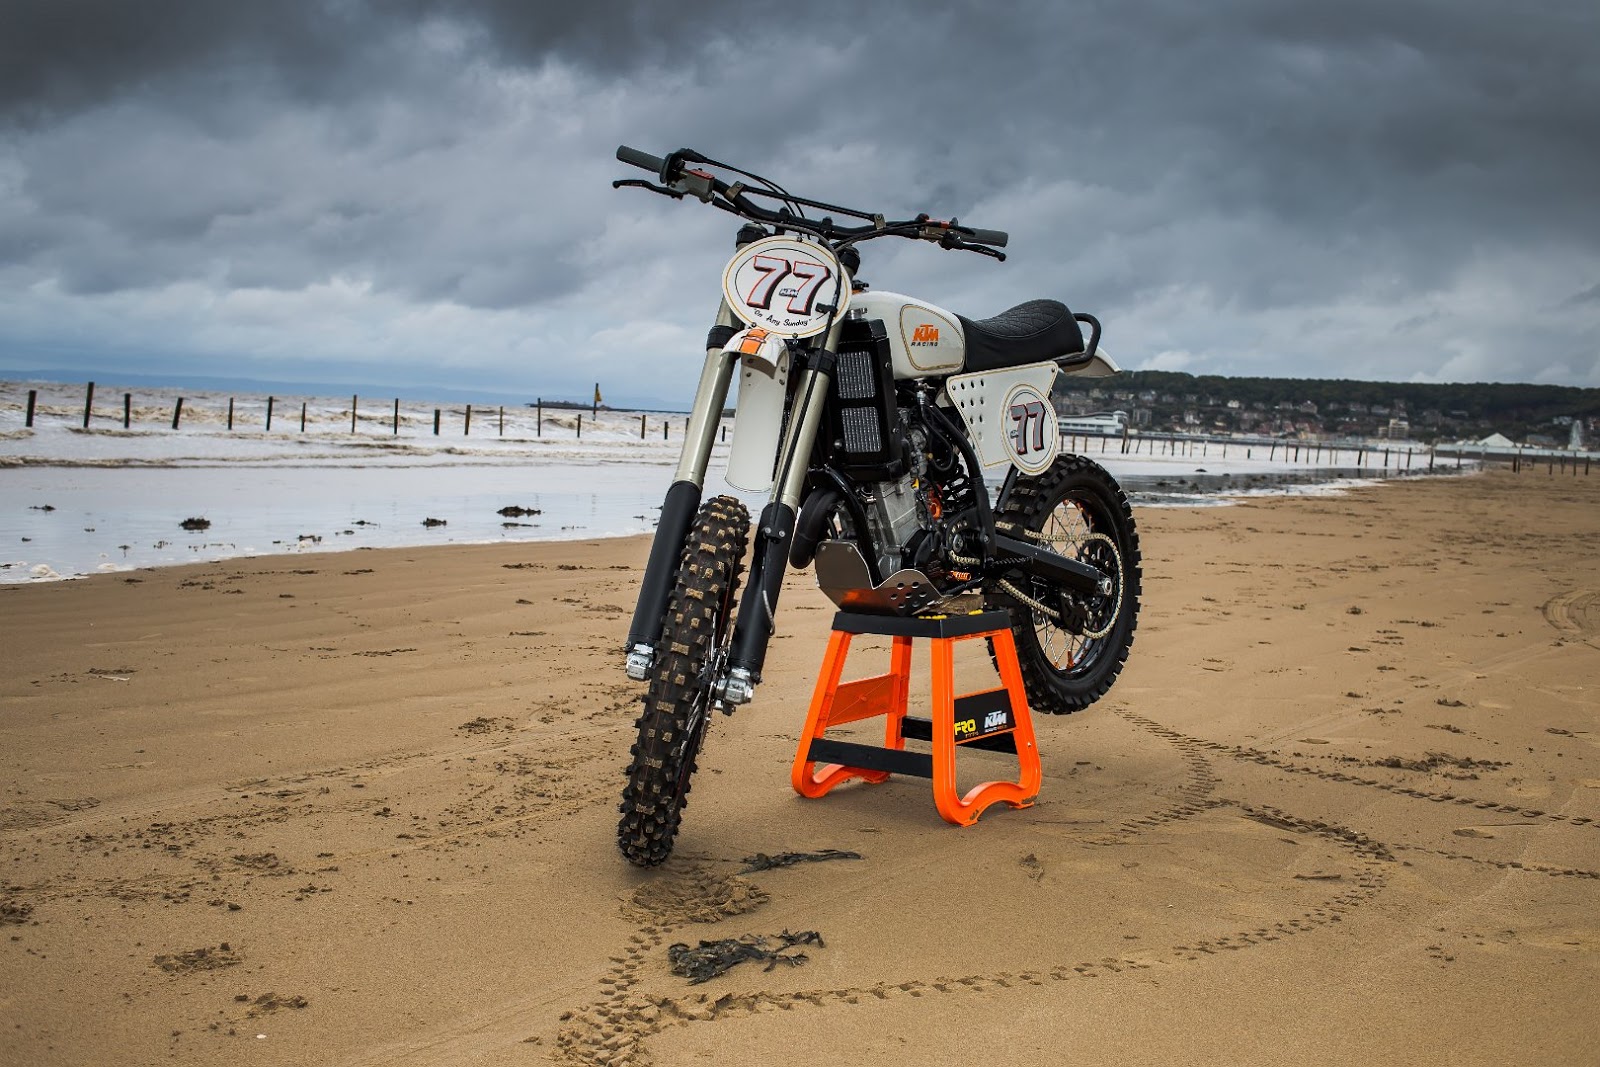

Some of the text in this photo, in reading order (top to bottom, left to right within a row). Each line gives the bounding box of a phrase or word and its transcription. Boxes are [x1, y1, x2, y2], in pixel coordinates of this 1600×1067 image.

[746, 255, 832, 316] 77
[766, 314, 781, 326] Any
[912, 324, 939, 342] KTM
[1010, 401, 1046, 455] 77
[984, 710, 1007, 728] KTM
